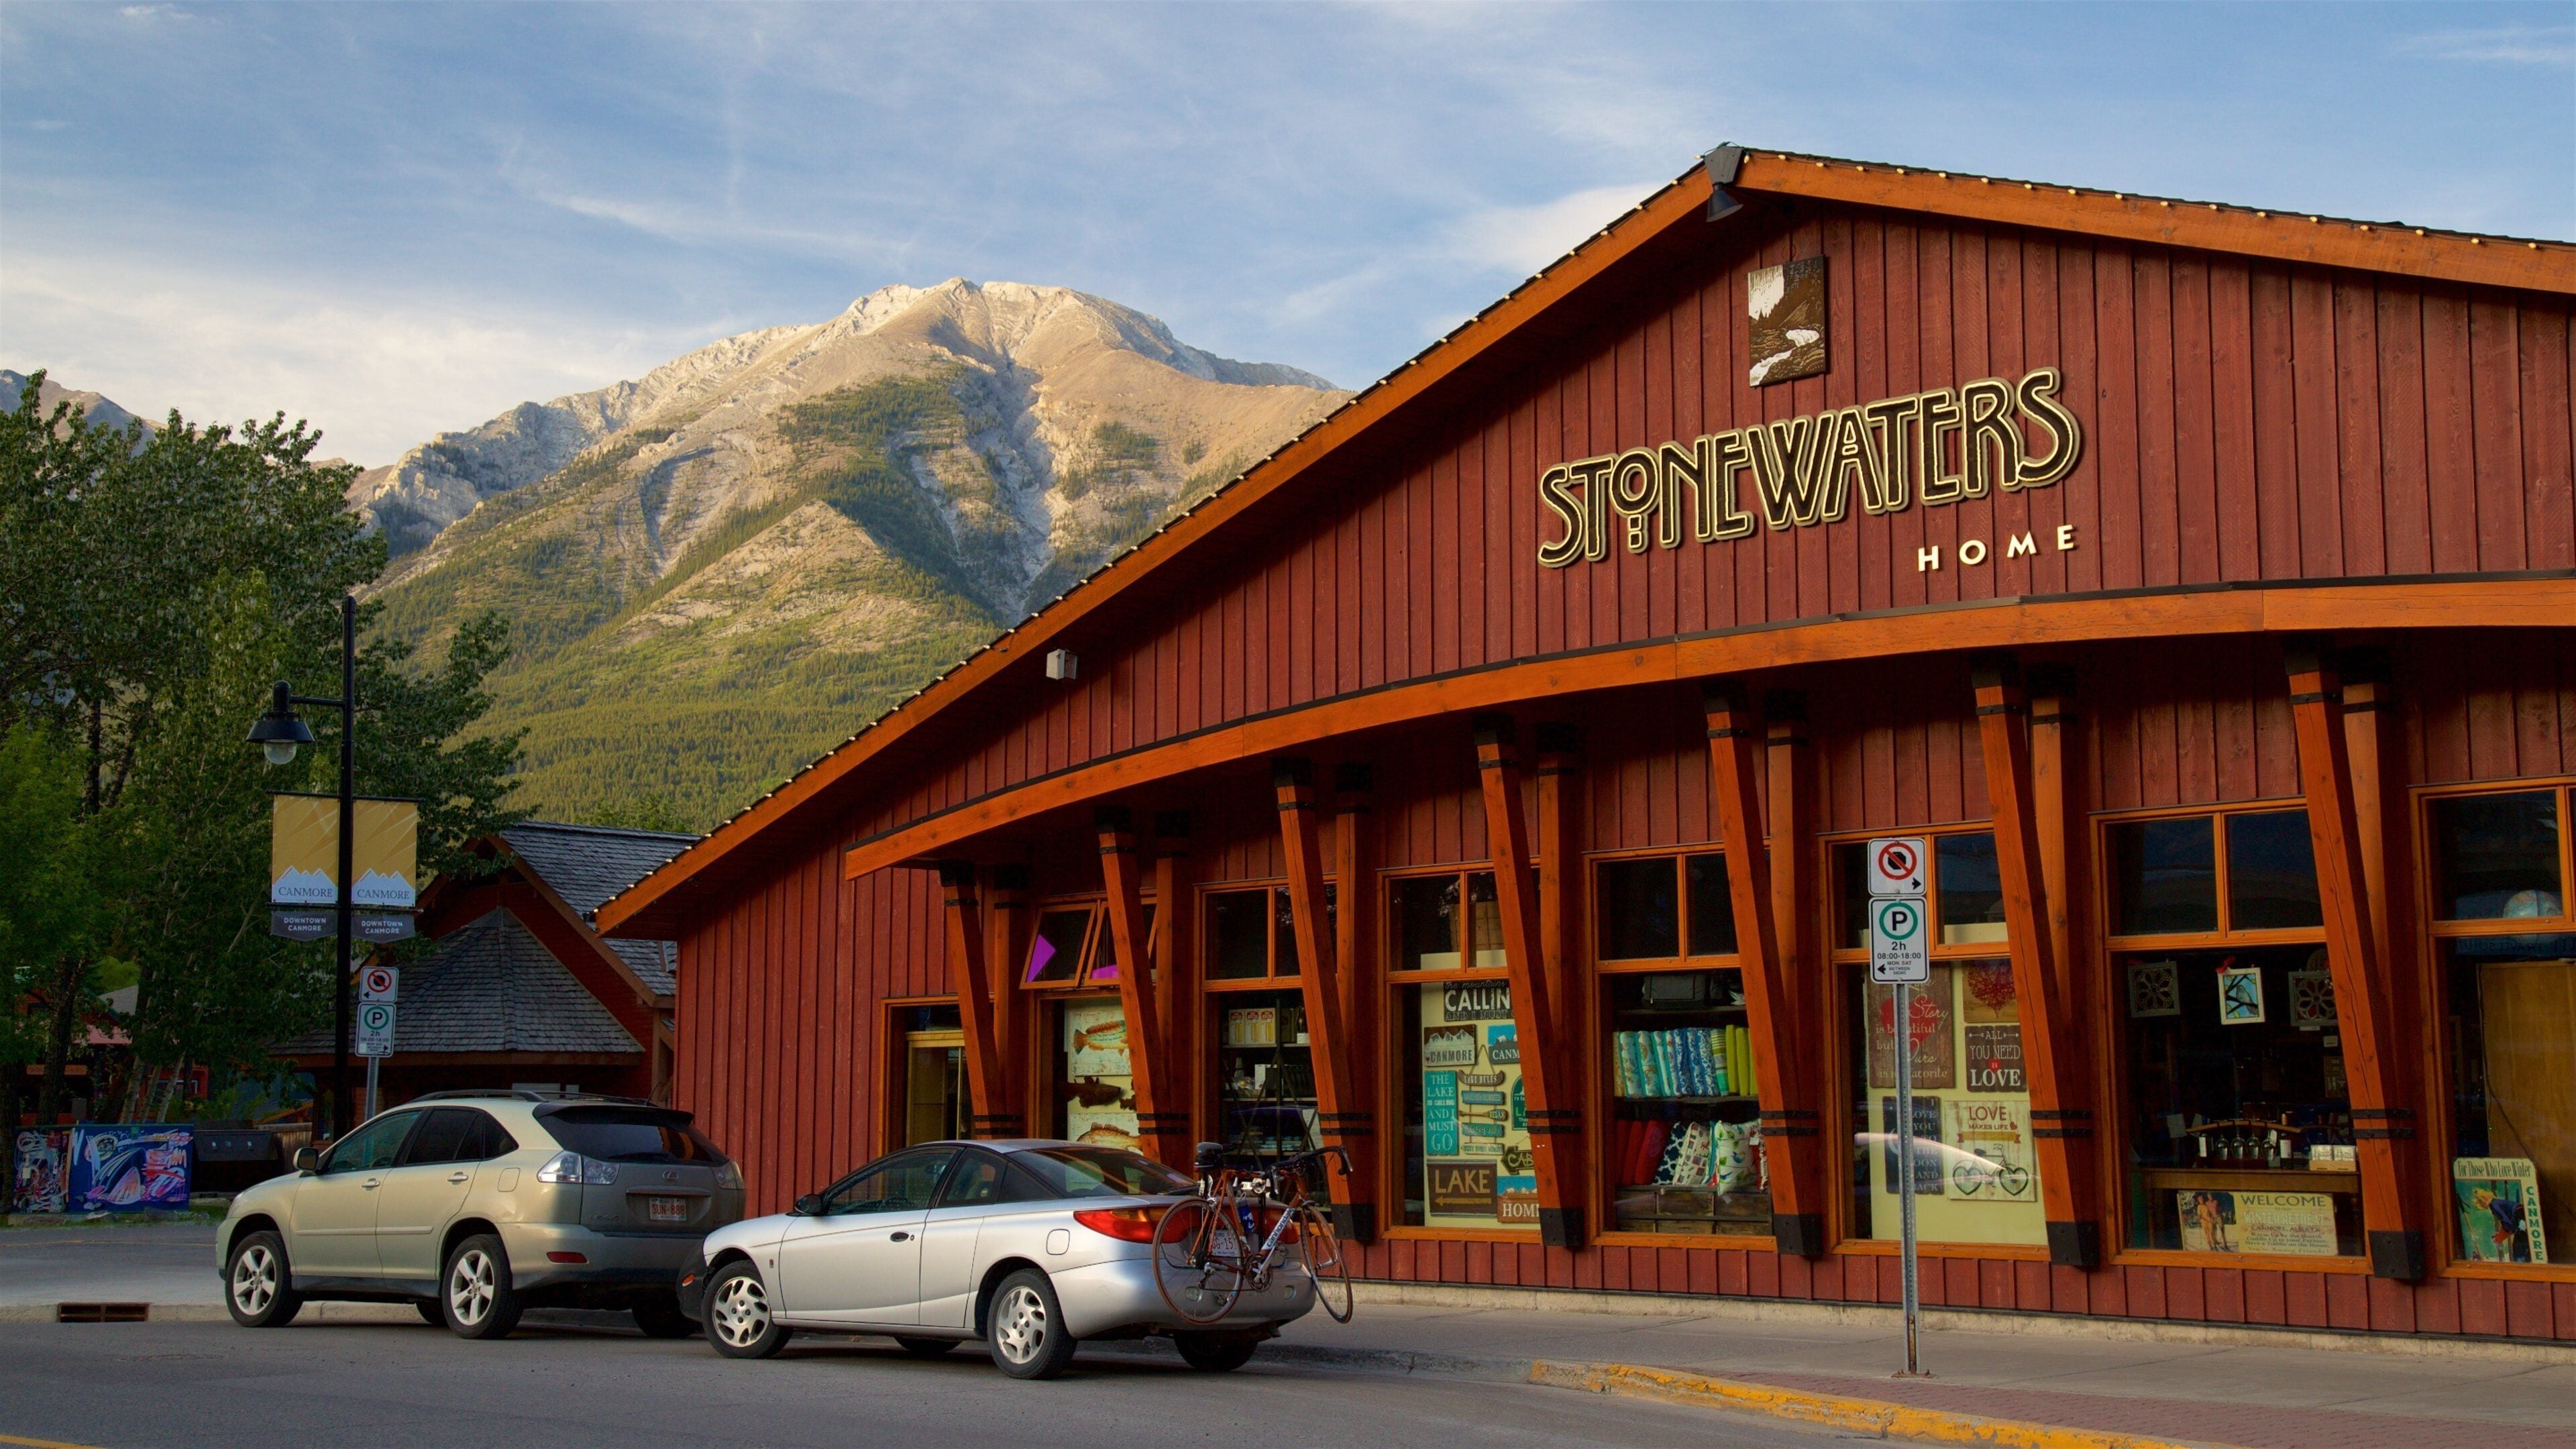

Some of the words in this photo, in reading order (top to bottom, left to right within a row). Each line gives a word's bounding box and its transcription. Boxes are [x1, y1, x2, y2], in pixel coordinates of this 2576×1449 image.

[1538, 367, 2080, 568] STONEWATERS
[1917, 524, 2076, 573] HOME
[278, 886, 333, 898] CANMORE
[356, 888, 410, 900] CANMORE
[1892, 911, 1908, 931] P
[1891, 941, 1907, 951] 2h
[1445, 987, 1510, 1012] CALLIN
[372, 1012, 383, 1024] P
[1445, 1010, 1468, 1021] AND
[1471, 1011, 1476, 1020] I
[1480, 1009, 1507, 1020] MUST
[1909, 994, 1949, 1030] Story
[1876, 1024, 1884, 1034] is
[1986, 1030, 2002, 1040] ALL
[1430, 1049, 1472, 1063] CANMORE
[1493, 1049, 1520, 1060] CANM
[1970, 1044, 1990, 1060] YOU
[1993, 1044, 2021, 1060] NEED
[1432, 1074, 1450, 1085] THE
[1970, 1068, 2021, 1087] LOVE
[1427, 1087, 1454, 1097] LAKE
[1428, 1109, 1449, 1119] AND
[1452, 1108, 1455, 1119] I
[1913, 1110, 1936, 1119] OVE
[1969, 1106, 2006, 1121] LOVE
[1428, 1120, 1455, 1131] MUST
[1913, 1122, 1935, 1131] YOU
[1432, 1133, 1452, 1151] GO
[1916, 1146, 1938, 1155] THE
[1914, 1159, 1937, 1167] OON
[2457, 1161, 2467, 1177] For
[2468, 1161, 2484, 1177] Those
[2484, 1161, 2498, 1177] Who
[2498, 1161, 2512, 1177] Love
[2512, 1161, 2532, 1177] Winter
[1916, 1171, 1939, 1179] AND
[1434, 1169, 1491, 1194] LAKE
[2241, 1194, 2326, 1208] WELCOME
[2243, 1212, 2279, 1225] WINTER
[2282, 1212, 2325, 1226] RETREAT
[2526, 1186, 2544, 1260] CANMORE
[1267, 1207, 1295, 1248] cannondale
[2290, 1225, 2320, 1234] ALBERTA
